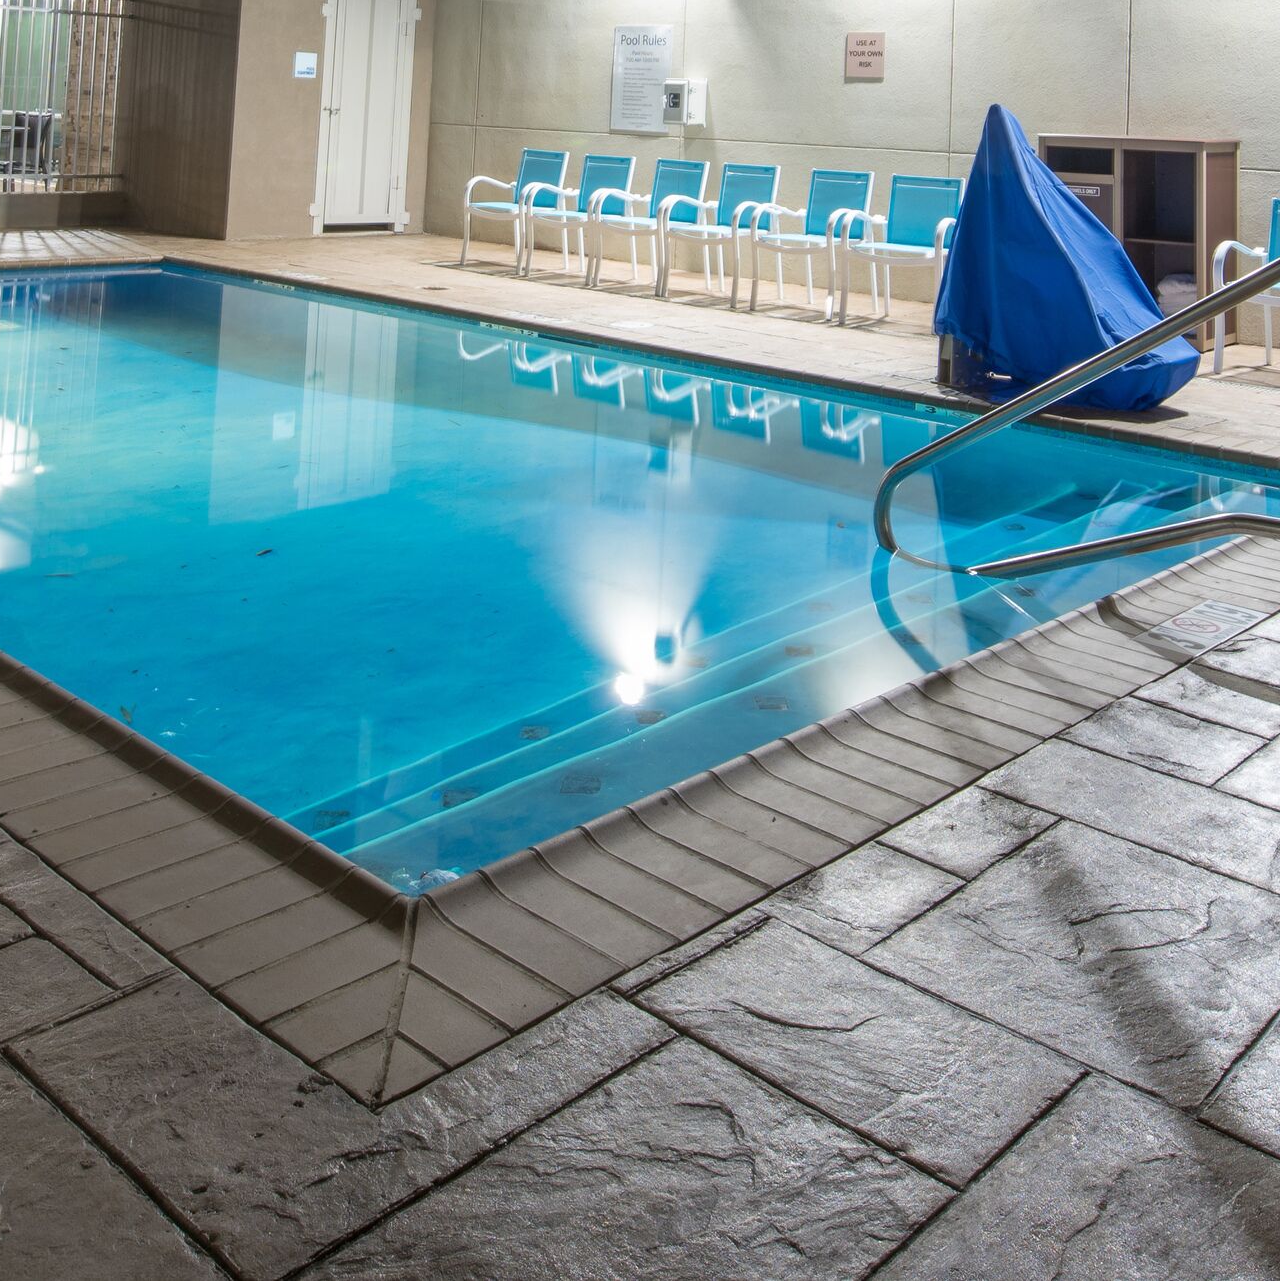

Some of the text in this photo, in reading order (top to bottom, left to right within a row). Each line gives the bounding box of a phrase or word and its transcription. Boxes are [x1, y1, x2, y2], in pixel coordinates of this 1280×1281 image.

[620, 34, 667, 46] Pool Rules
[1148, 632, 1206, 650] 3
